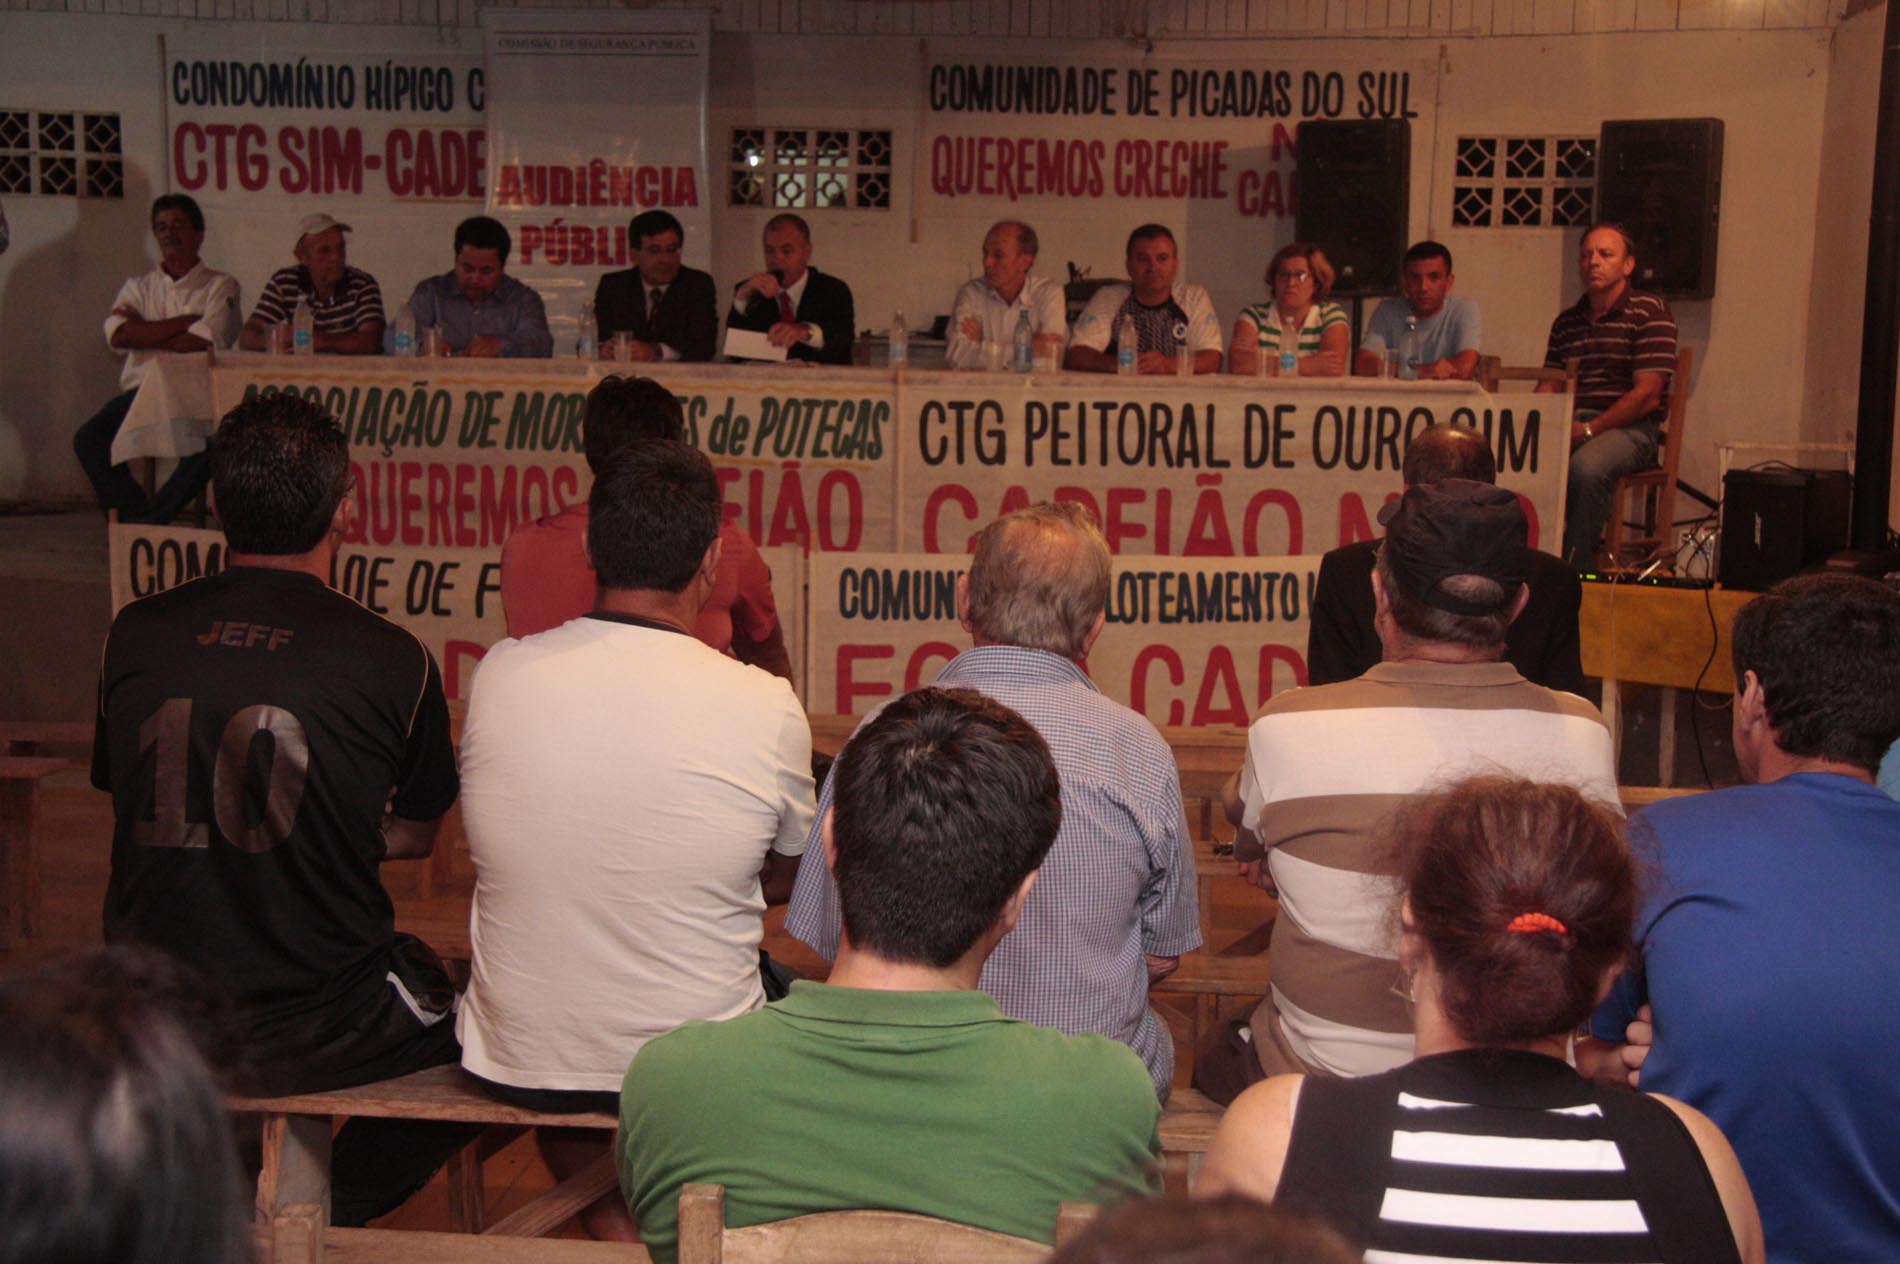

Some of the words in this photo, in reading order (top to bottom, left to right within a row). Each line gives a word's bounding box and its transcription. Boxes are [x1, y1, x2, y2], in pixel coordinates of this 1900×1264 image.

[172, 57, 355, 110] CONDOMÍNIO
[366, 60, 454, 112] HÍPICO
[930, 64, 1117, 116] COMUNIDADE
[1127, 69, 1160, 118] DE
[1171, 68, 1292, 119] PICADAS
[1303, 71, 1345, 119] DO
[1358, 71, 1418, 119] SUL
[173, 121, 270, 192] CTG
[498, 158, 698, 207] AUDIÊNCIA
[931, 135, 1105, 202] QUEREMOS
[1114, 139, 1230, 200] CRECHE
[520, 217, 638, 266] PÚBLI
[457, 389, 504, 450] DE
[707, 397, 750, 458] de
[753, 397, 890, 461] POTECAS
[919, 400, 1007, 466] CTG
[1024, 401, 1231, 469] PEITORAL
[1243, 404, 1297, 470] DE
[923, 472, 1304, 558] CEIÃO
[406, 559, 461, 617] DE
[196, 620, 295, 651] JEFF
[137, 698, 308, 853] 10
